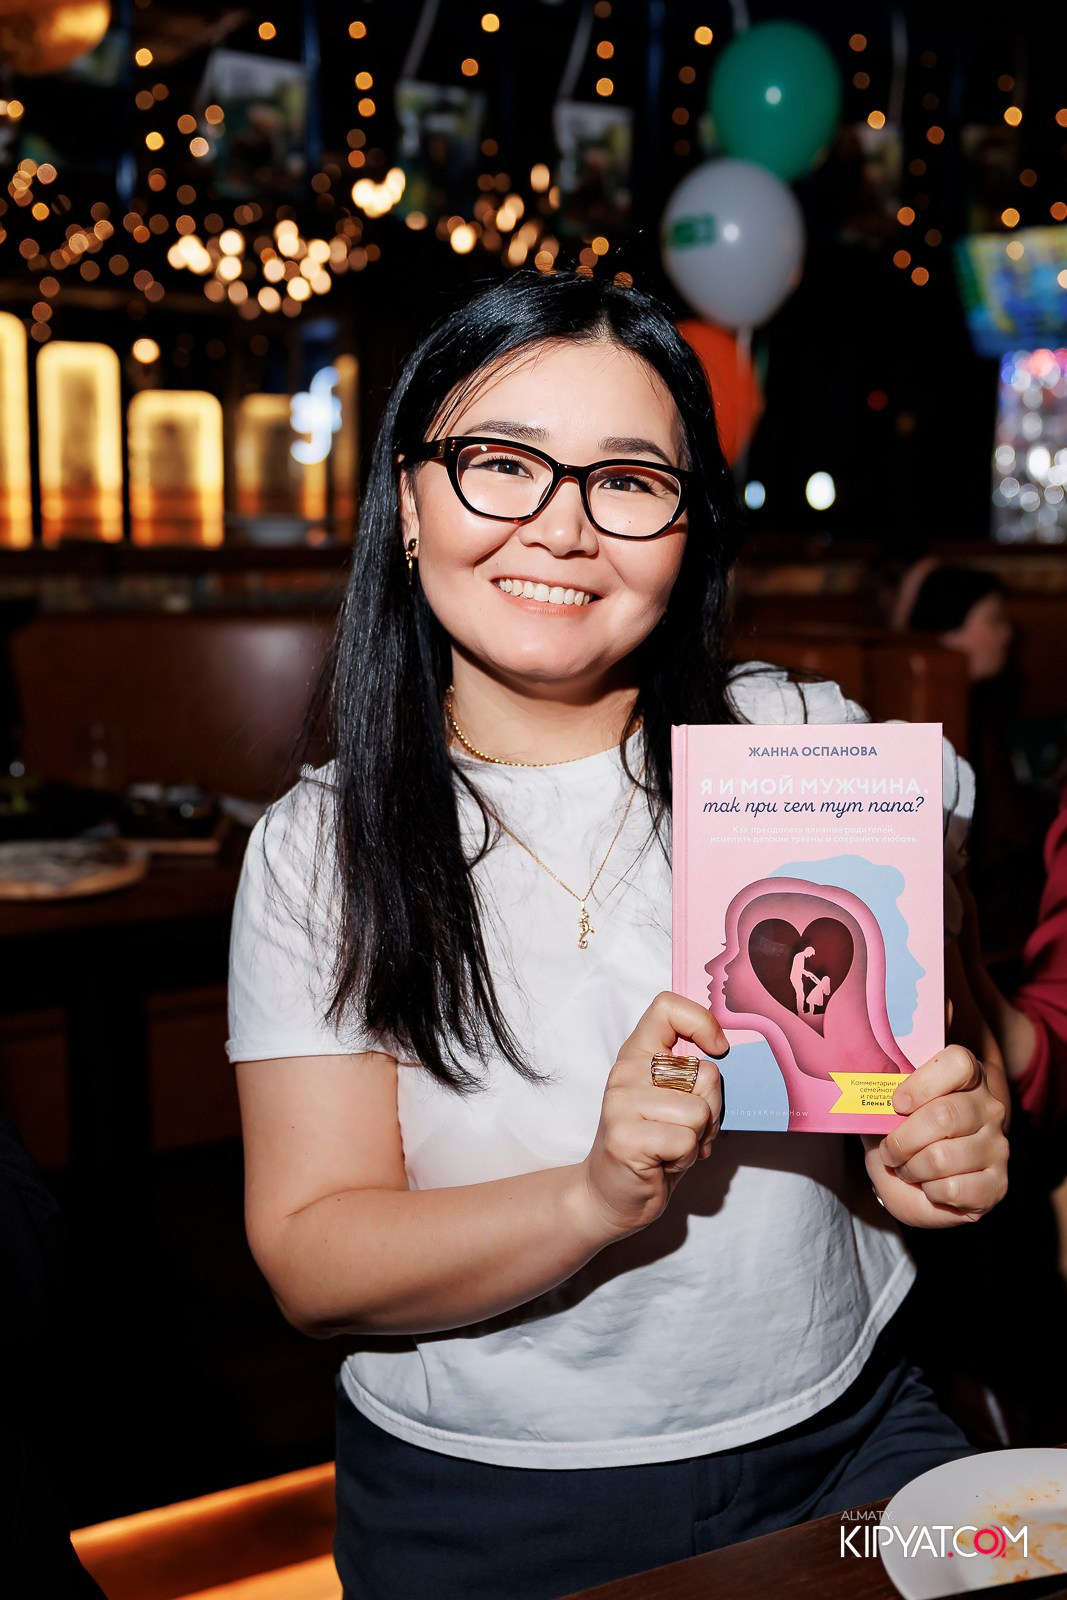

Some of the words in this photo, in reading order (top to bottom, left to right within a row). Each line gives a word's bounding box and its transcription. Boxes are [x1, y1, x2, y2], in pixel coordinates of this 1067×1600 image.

[748, 746, 799, 757] ЖАННА
[801, 746, 878, 757] ОСПАНОВА
[700, 778, 713, 795] Я
[719, 778, 734, 795] И
[741, 774, 793, 795] МОЙ
[702, 796, 741, 813] так
[744, 801, 778, 818] при
[783, 801, 816, 813] чем
[819, 801, 864, 819] тут
[867, 796, 925, 813] папа?
[732, 825, 749, 834] Как
[750, 825, 803, 835] преодолеть
[710, 835, 752, 844] исцелить
[753, 835, 790, 845] детские
[791, 836, 825, 845] травмы
[825, 836, 832, 844] и
[833, 836, 881, 845] сохранить
[881, 835, 917, 844] любовь
[850, 1080, 897, 1088] Комментарии
[861, 1099, 885, 1107] Елены
